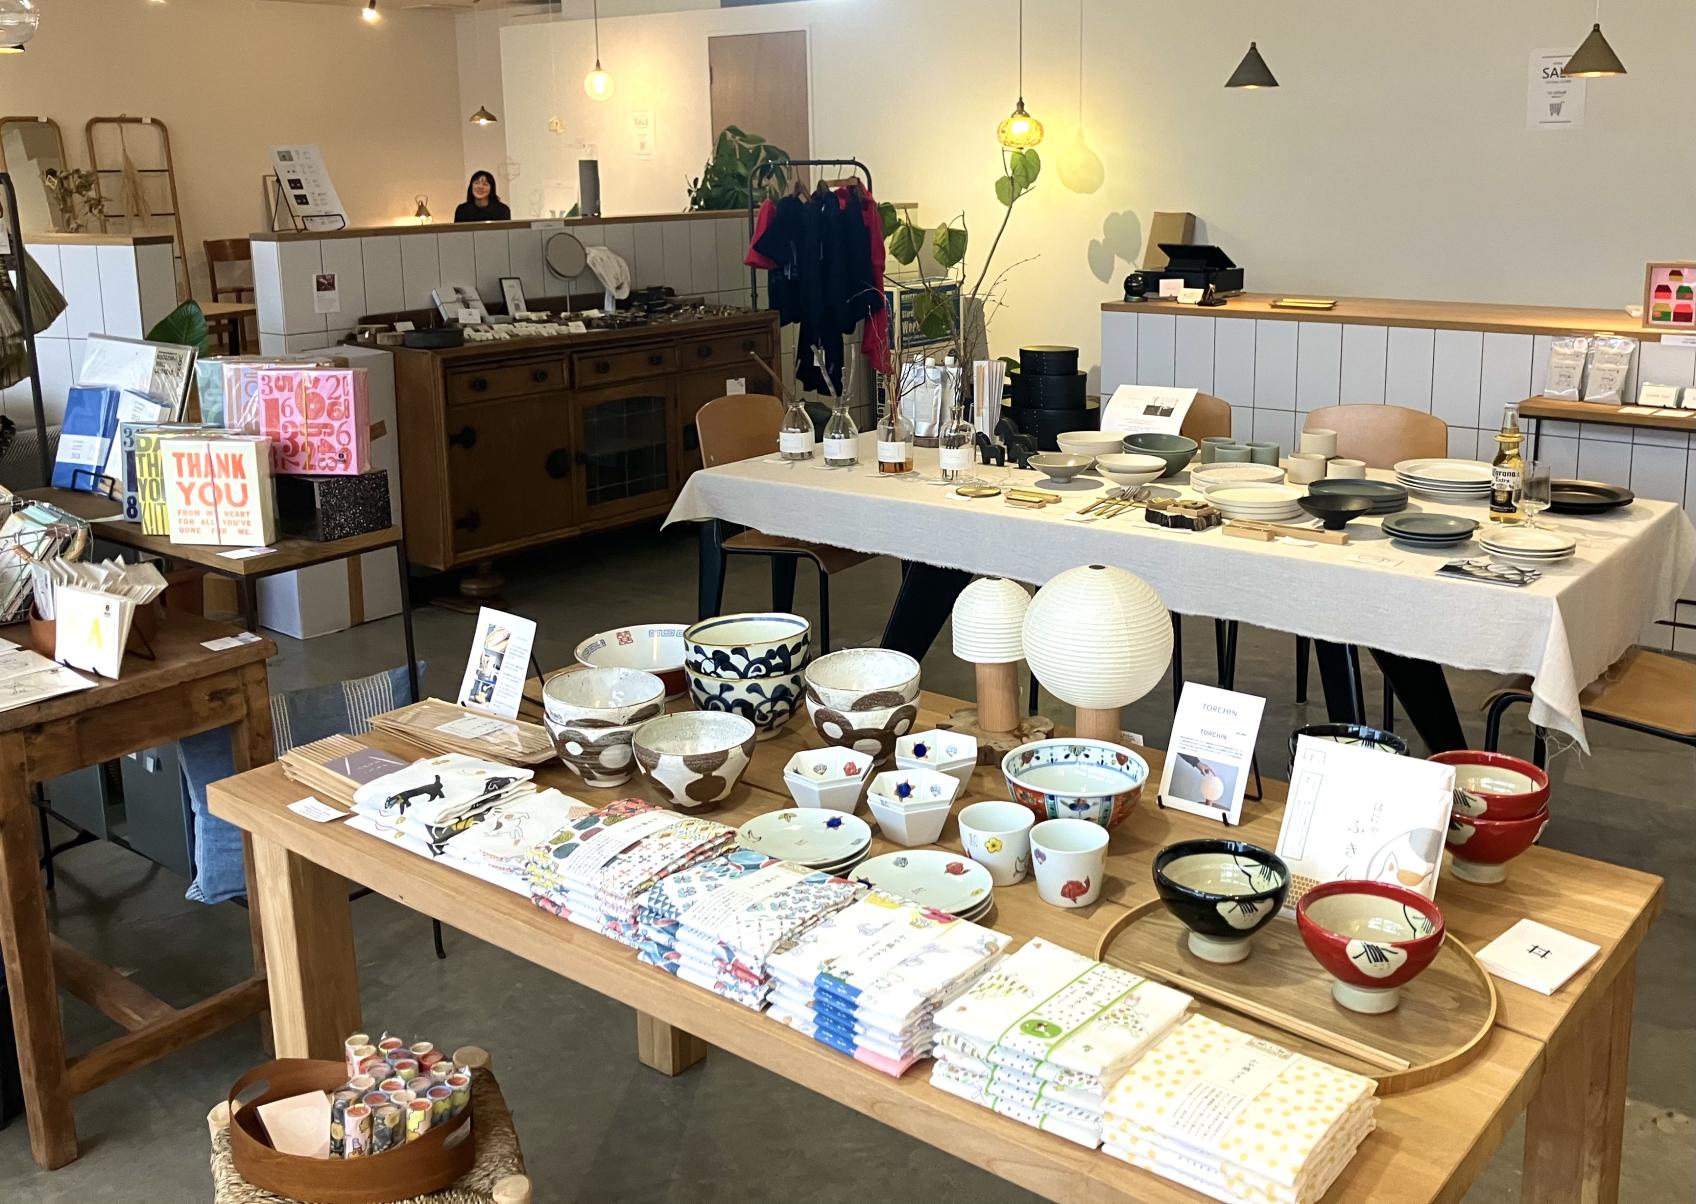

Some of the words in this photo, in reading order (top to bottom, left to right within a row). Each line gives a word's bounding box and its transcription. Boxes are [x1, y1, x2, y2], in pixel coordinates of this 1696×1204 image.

[1542, 67, 1568, 79] SAL
[172, 452, 246, 479] THANK
[176, 481, 248, 508] YOU
[1203, 704, 1238, 716] TORCHIN
[1200, 729, 1228, 740] TORCHIN
